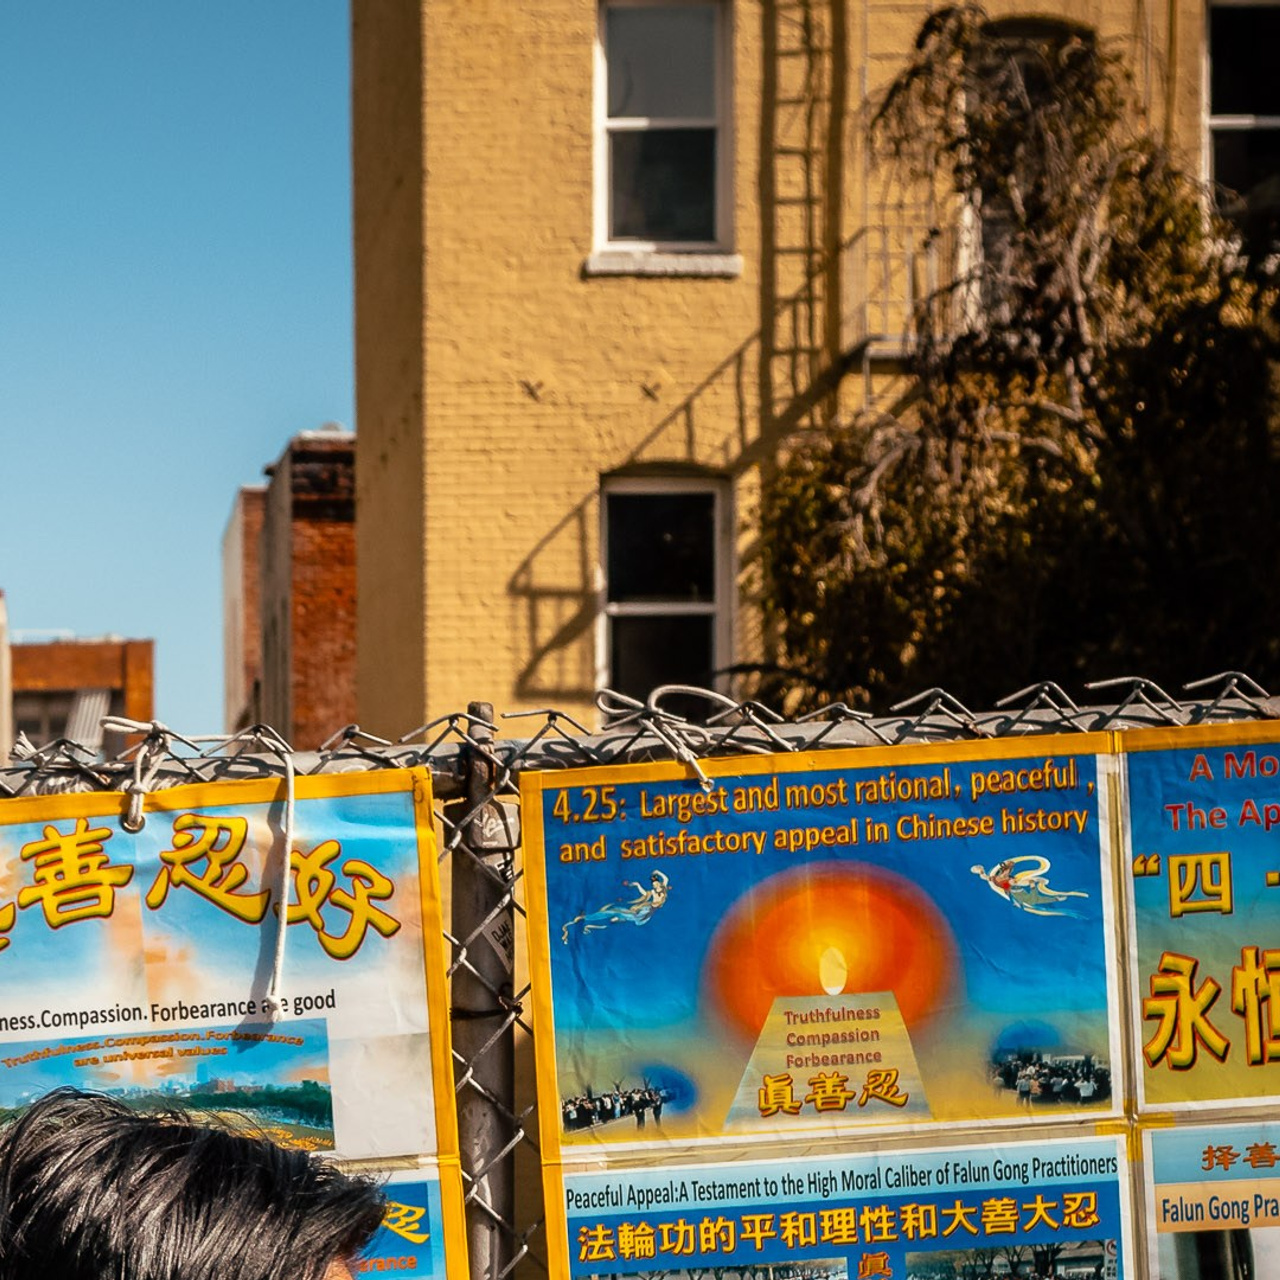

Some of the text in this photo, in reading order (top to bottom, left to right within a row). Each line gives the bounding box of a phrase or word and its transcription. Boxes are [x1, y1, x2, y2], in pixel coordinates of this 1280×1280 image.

[1189, 754, 1214, 781] A
[552, 786, 627, 823] 4.25:
[640, 788, 728, 822] Largest
[733, 776, 779, 811] and
[785, 777, 848, 810] most
[1165, 801, 1228, 831] The
[559, 808, 1088, 863] and satisfactory appeal in Chinese history
[150, 999, 257, 1023] Forbearance
[261, 999, 289, 1016] ae
[294, 989, 336, 1016] good
[784, 1007, 881, 1025] Truthfulness
[786, 1028, 880, 1047] Compassion
[73, 1045, 228, 1068] are universal values
[786, 1051, 882, 1068] Forbearance
[566, 1184, 621, 1210] Peaceful
[691, 1177, 761, 1201] Testament
[764, 1179, 778, 1195] to
[781, 1173, 804, 1195] the
[808, 1170, 838, 1198] High
[842, 1166, 881, 1192] Moral
[885, 1163, 933, 1188] Caliber
[936, 1162, 950, 1185] of
[953, 1160, 989, 1184] Falun
[993, 1159, 1030, 1184] Gong
[1033, 1154, 1118, 1178] Practitioners
[1162, 1196, 1204, 1223] Falun
[1209, 1195, 1250, 1224] Gong
[577, 1191, 1101, 1262] 法輪功的平和理性和大善大忍
